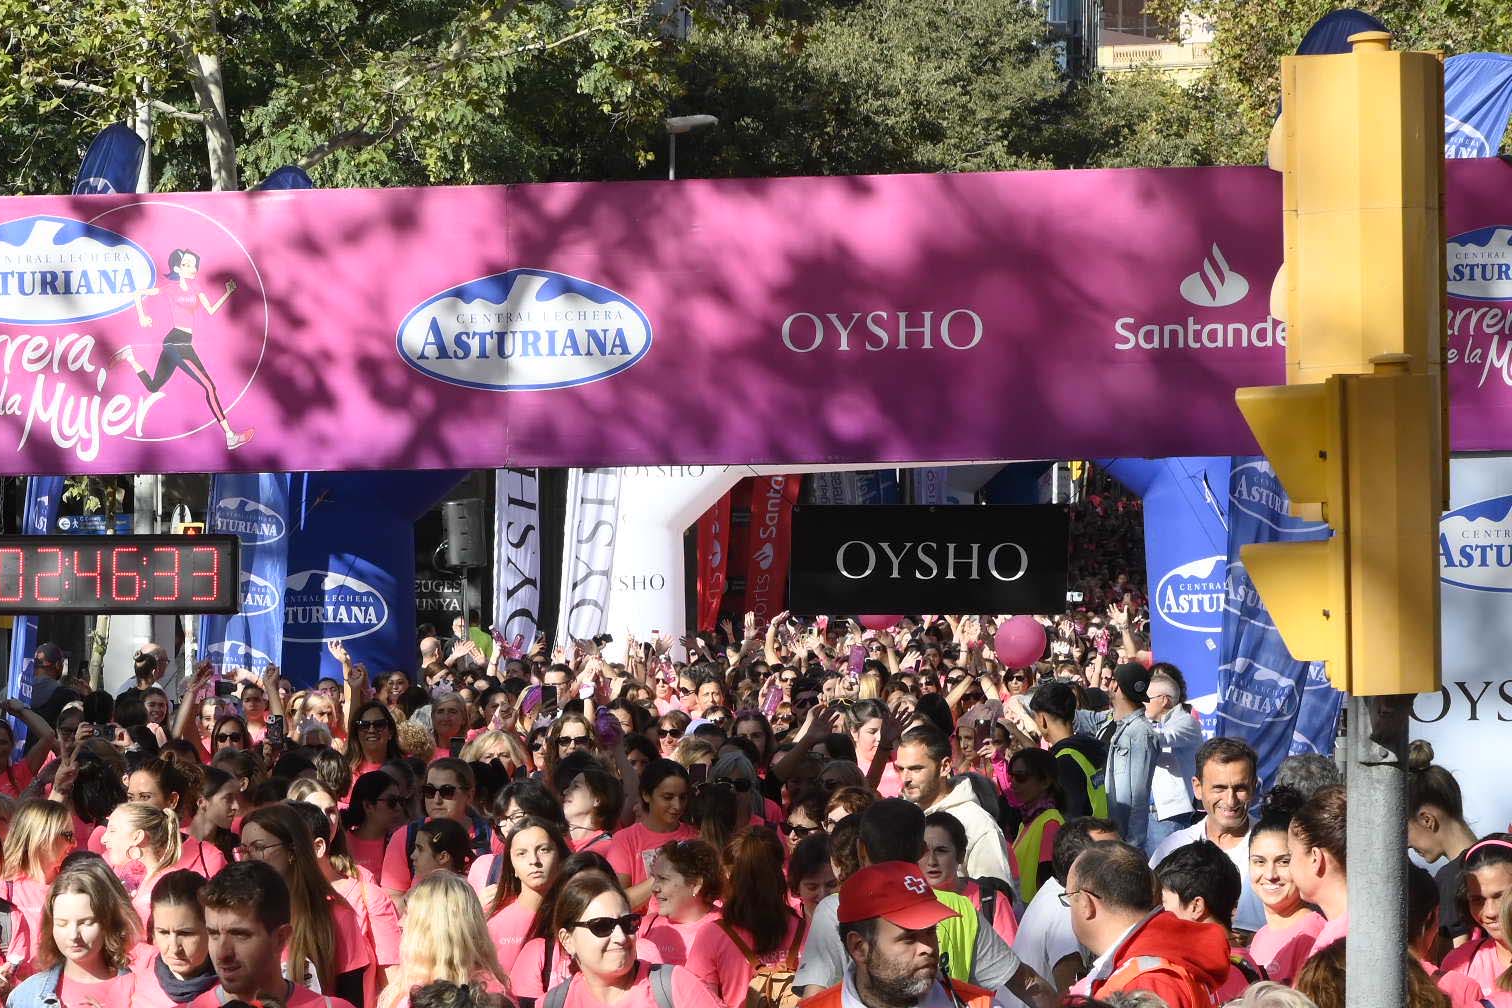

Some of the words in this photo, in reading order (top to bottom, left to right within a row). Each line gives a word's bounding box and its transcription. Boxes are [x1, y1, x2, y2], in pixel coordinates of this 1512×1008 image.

[58, 253, 131, 264] LECHERA
[1455, 251, 1506, 260] CENTRAL
[457, 312, 533, 324] CENTRAL
[543, 310, 623, 322] LECHERA
[781, 309, 984, 353] OYSHO
[1114, 316, 1286, 350] Santande
[417, 316, 631, 360] ASTURIANA
[17, 367, 166, 462] Mujer
[217, 518, 277, 538] STURIANA
[1461, 530, 1512, 539] CENTR
[505, 467, 538, 640] OYSH
[569, 468, 616, 640] OYSH
[836, 540, 1028, 582] OYSHO
[1438, 531, 1512, 568] ASTU
[285, 606, 378, 625] TURIANA
[325, 594, 374, 603] LECHERA
